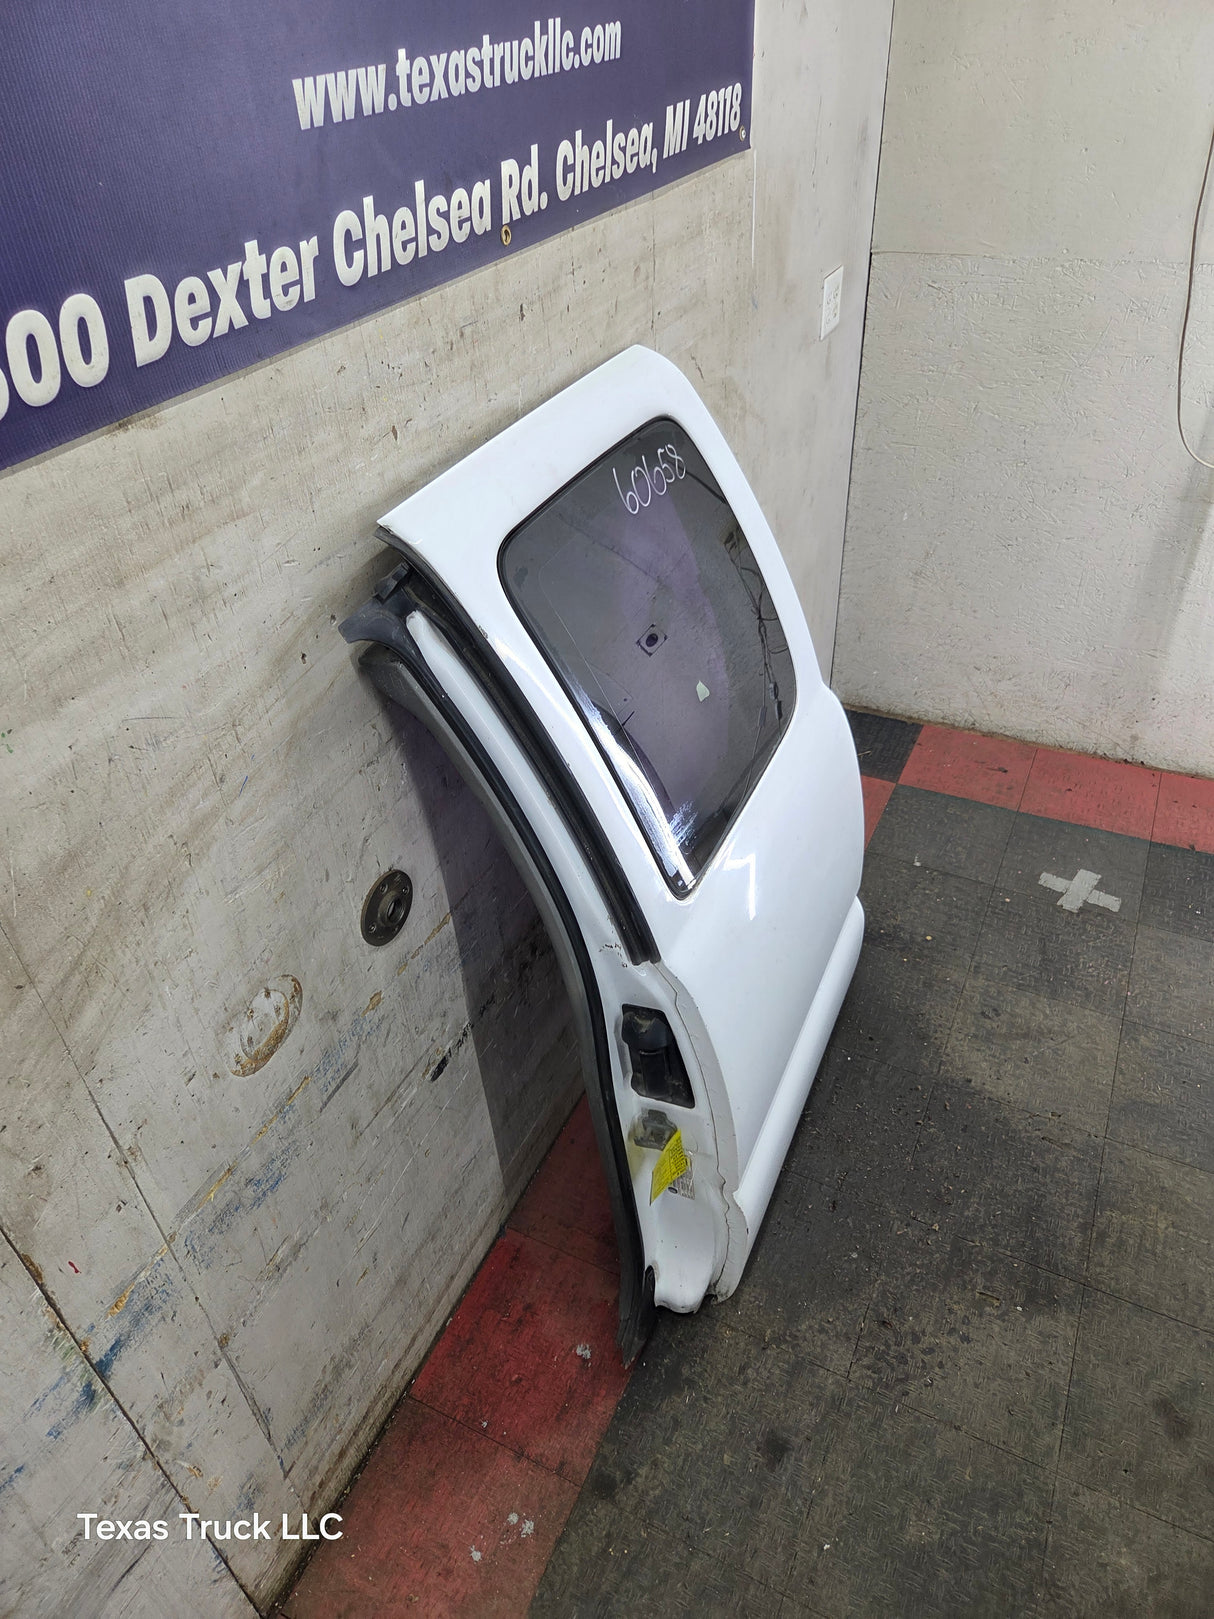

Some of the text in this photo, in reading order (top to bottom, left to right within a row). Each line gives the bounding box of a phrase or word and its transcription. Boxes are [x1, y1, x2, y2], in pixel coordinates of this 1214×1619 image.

[292, 17, 622, 130] www.texastruckllc.com
[0, 82, 742, 421] 00 Dexter Chelsea Rd. Chelsea, MI 48118
[612, 444, 686, 515] 60658
